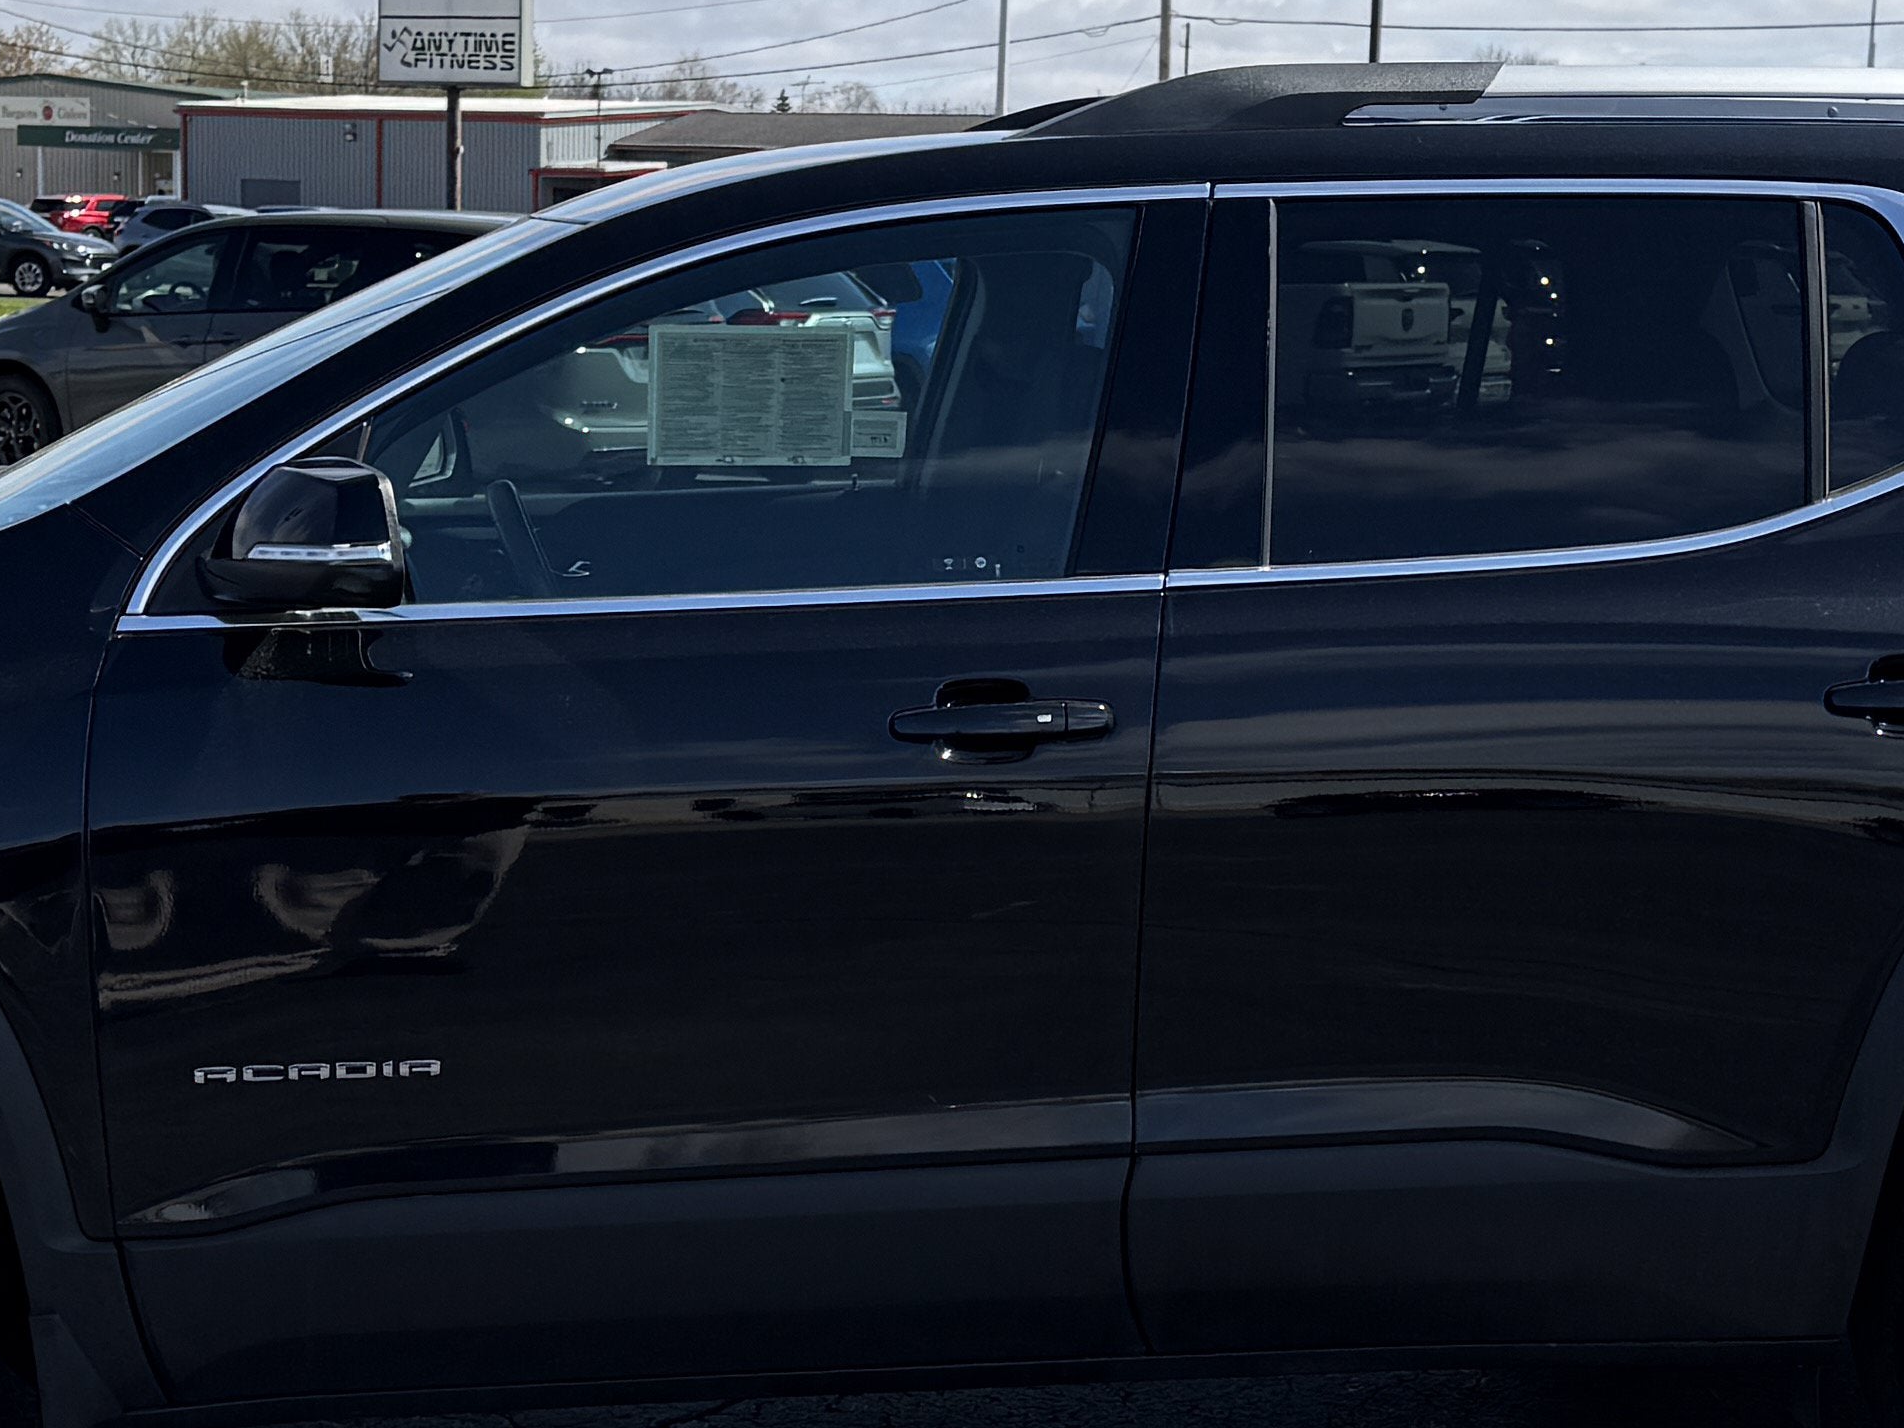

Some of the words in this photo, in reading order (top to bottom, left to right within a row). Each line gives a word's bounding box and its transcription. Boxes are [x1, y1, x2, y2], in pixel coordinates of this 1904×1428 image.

[411, 31, 516, 53] ANYTIME
[413, 53, 516, 71] FITNESS
[65, 130, 115, 144] Donation
[194, 1059, 441, 1083] ACADIA
